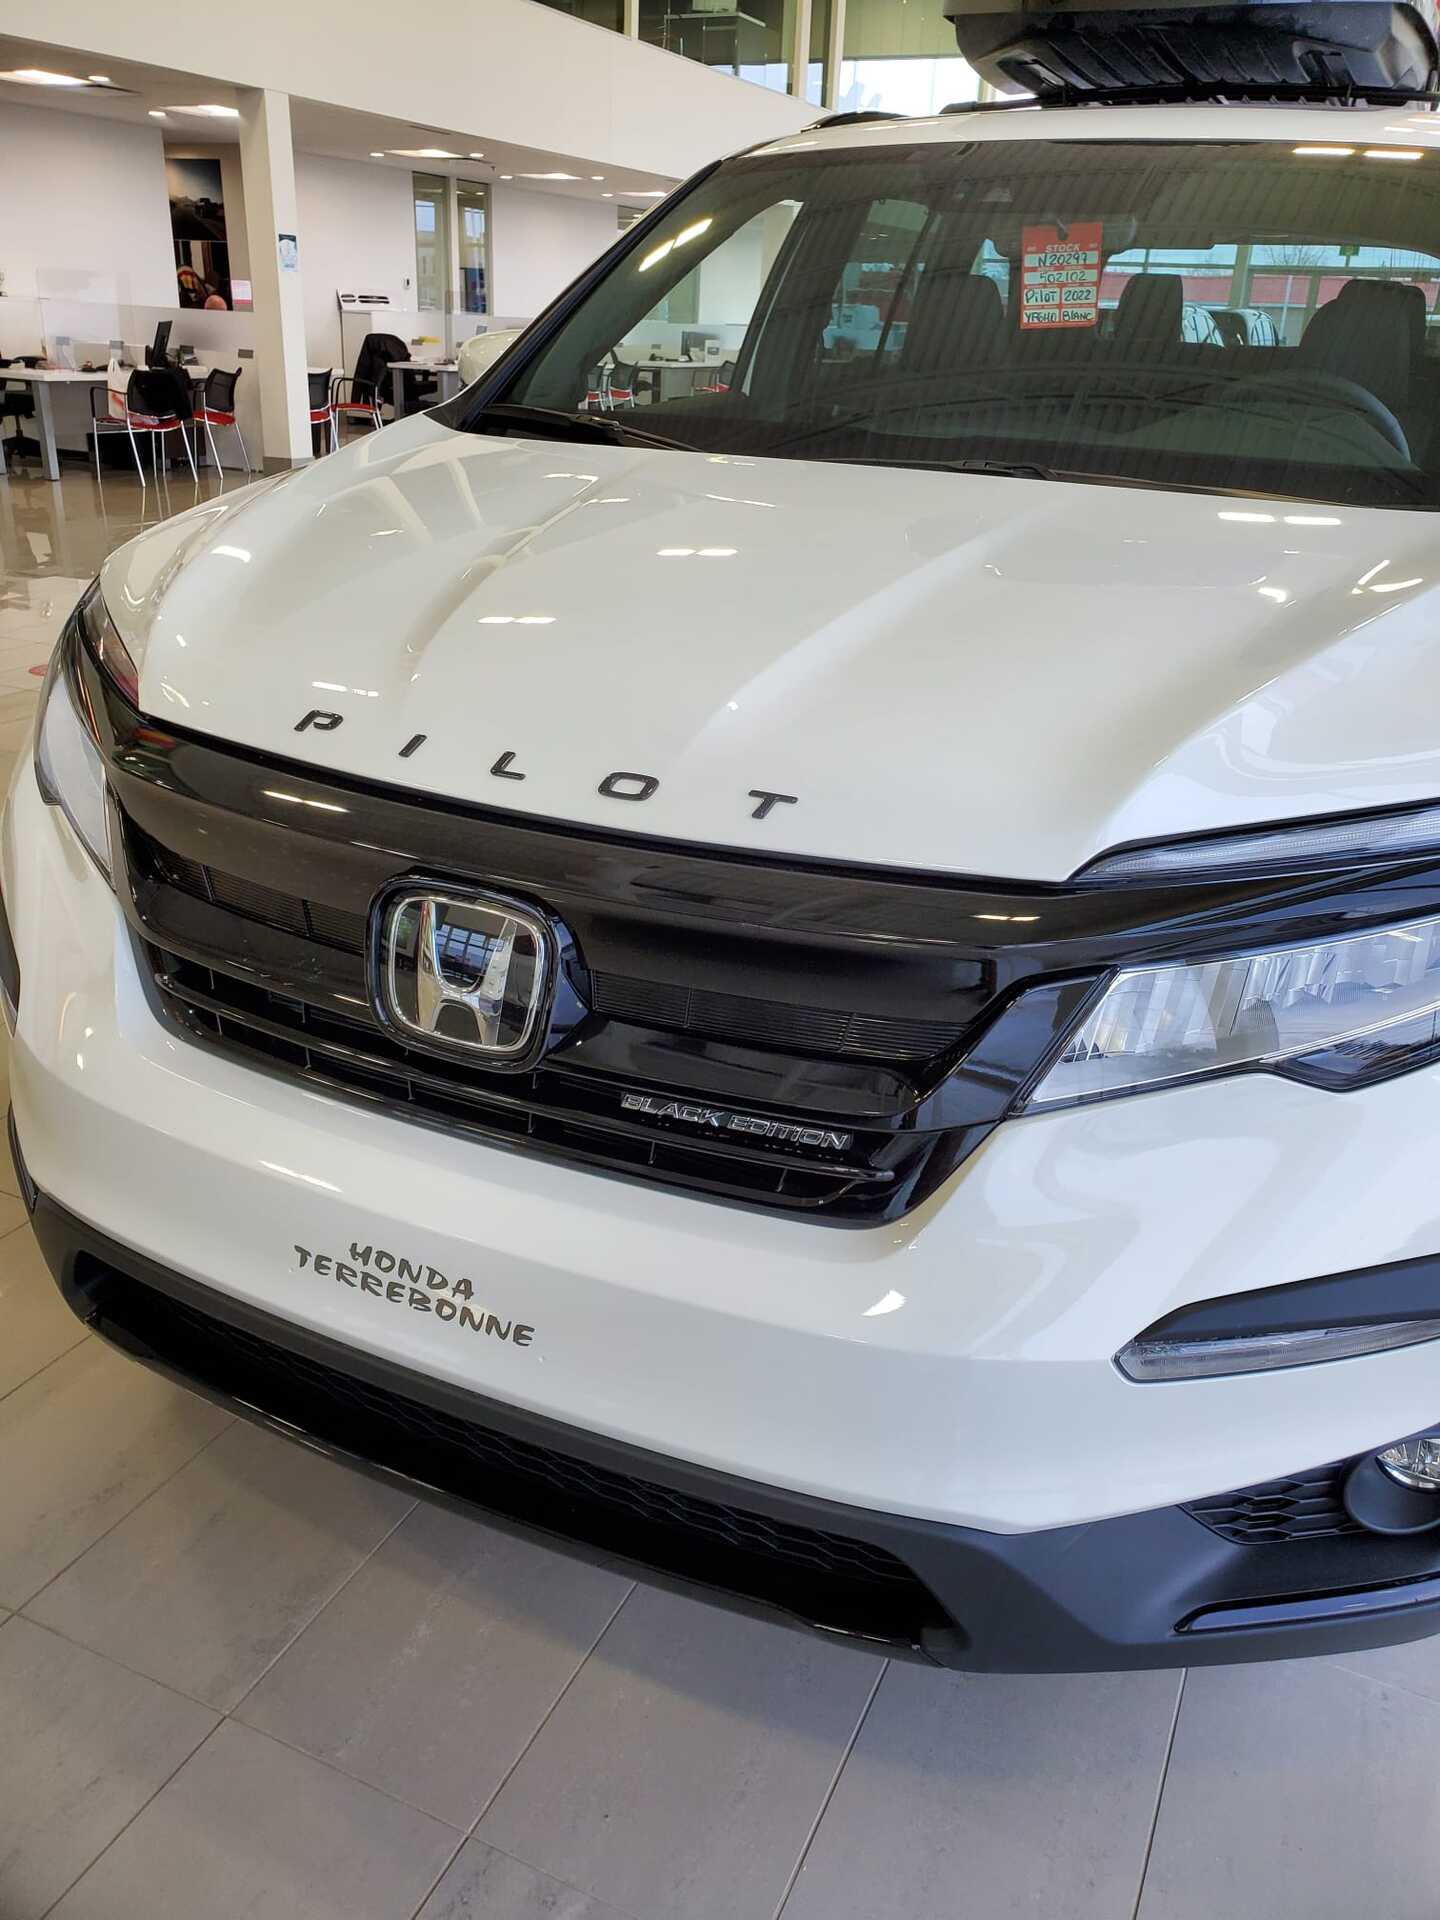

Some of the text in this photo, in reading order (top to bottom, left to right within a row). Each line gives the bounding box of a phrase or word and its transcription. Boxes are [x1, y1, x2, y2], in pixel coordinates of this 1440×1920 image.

[1045, 243, 1080, 253] STOCK
[1064, 289, 1092, 302] 2022
[293, 708, 799, 820] PILOT
[621, 1093, 850, 1151] BLACK EDITION
[294, 1244, 536, 1347] TERREBONNE
[350, 1242, 474, 1301] HONDA
